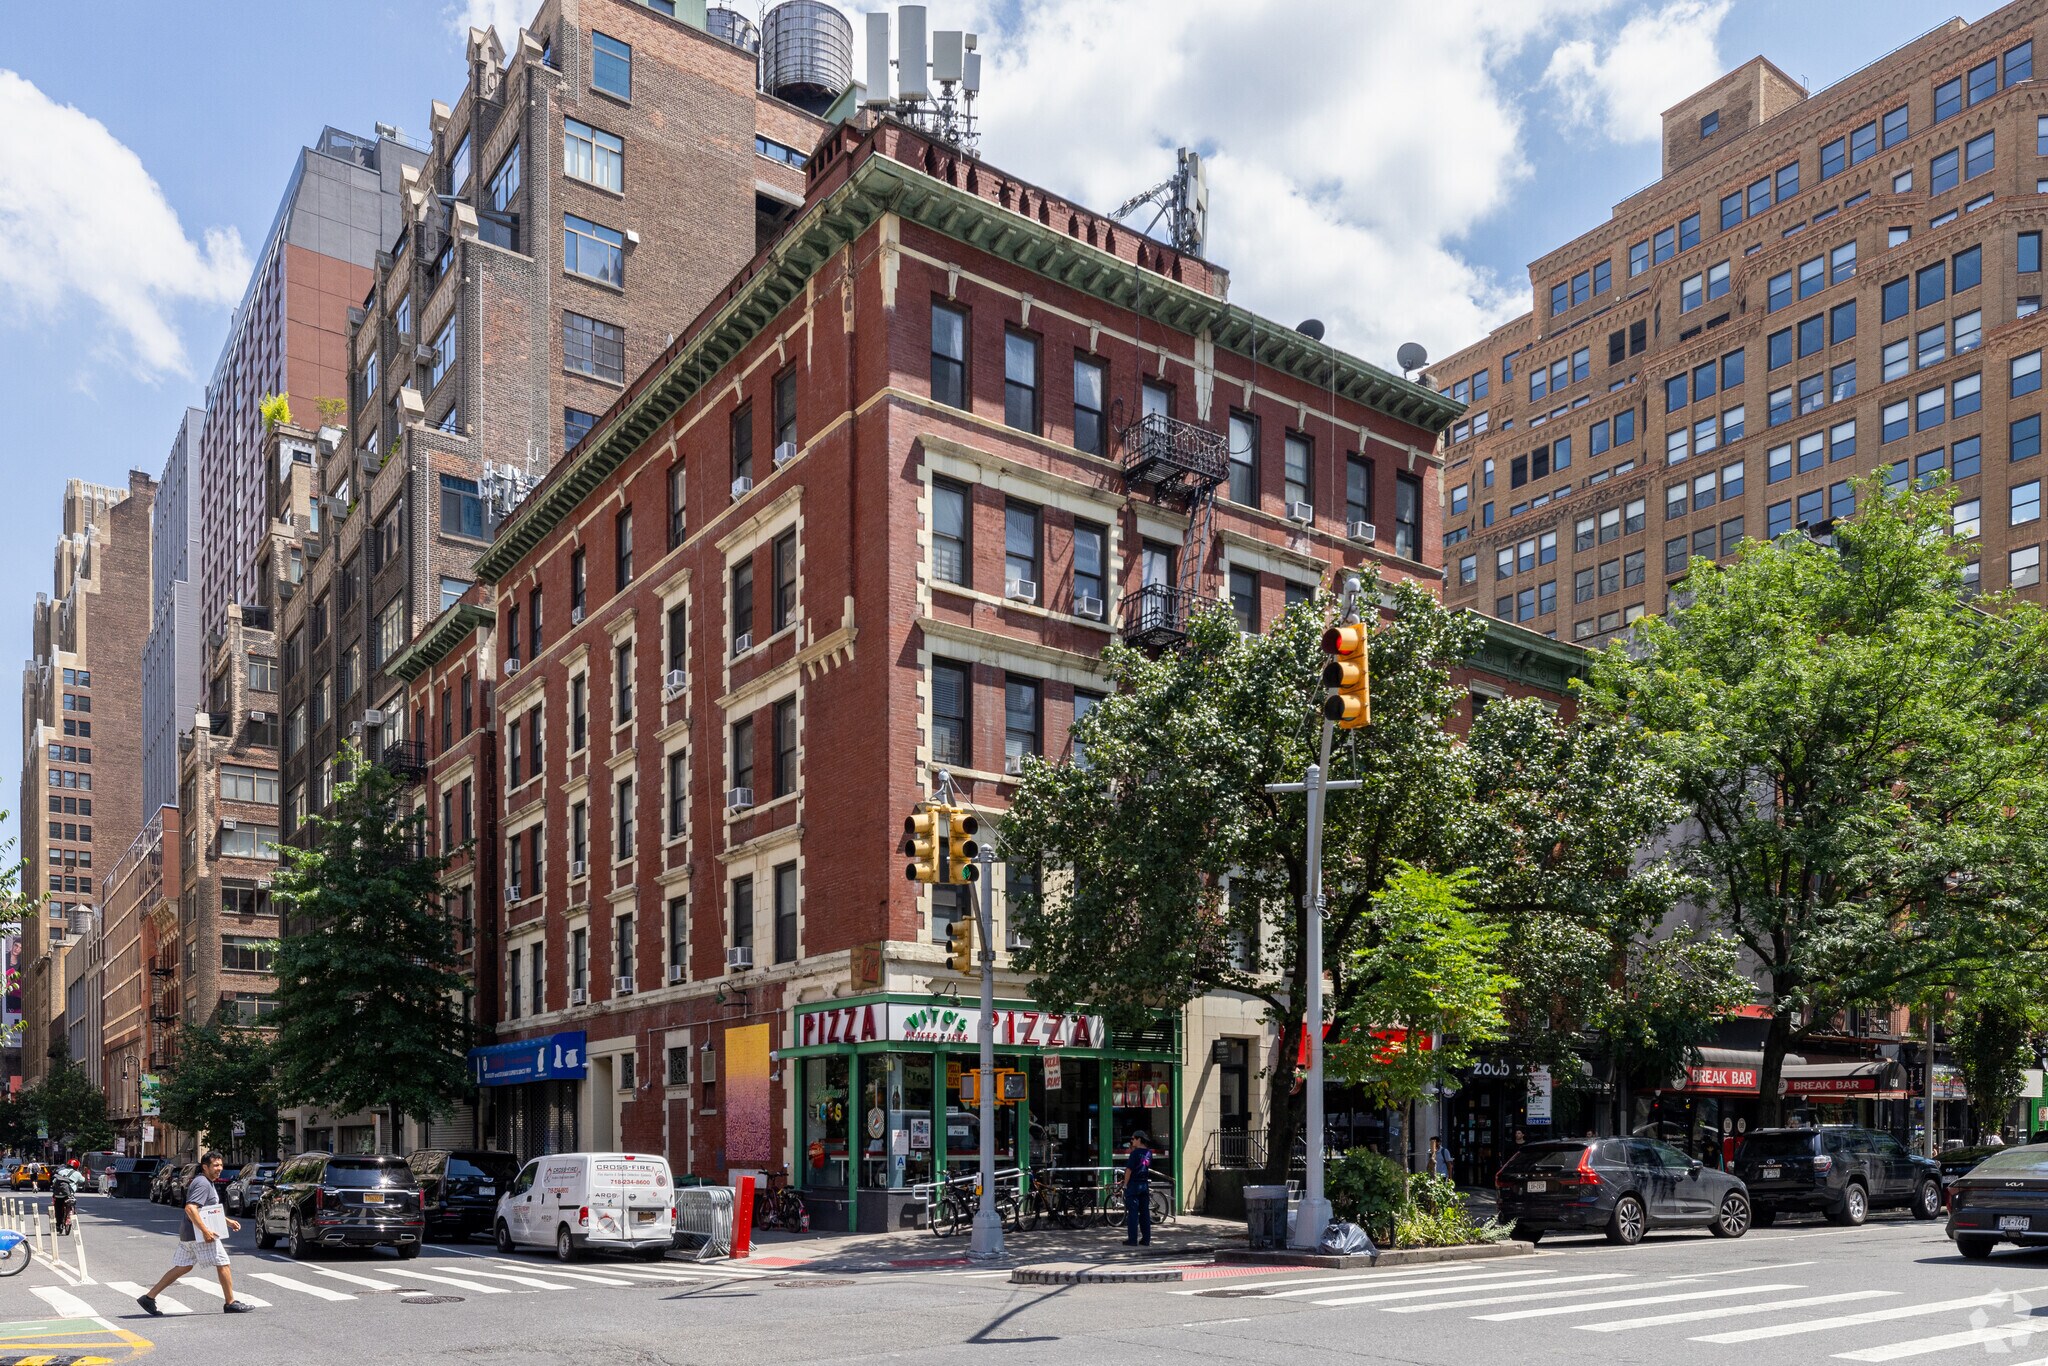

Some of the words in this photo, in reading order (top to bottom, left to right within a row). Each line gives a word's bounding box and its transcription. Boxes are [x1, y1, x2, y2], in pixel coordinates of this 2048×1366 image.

[804, 1005, 877, 1046] PIZZA
[906, 1006, 968, 1032] VITO'S
[905, 1031, 938, 1039] SLICES
[947, 1033, 969, 1041] ICES
[1044, 1055, 1060, 1068] PIZZA
[1692, 1069, 1728, 1084] BREAK
[1731, 1071, 1753, 1085] BAR
[1793, 1080, 1831, 1090] BREAK
[1835, 1080, 1859, 1089] BAR
[897, 1157, 905, 1166] A
